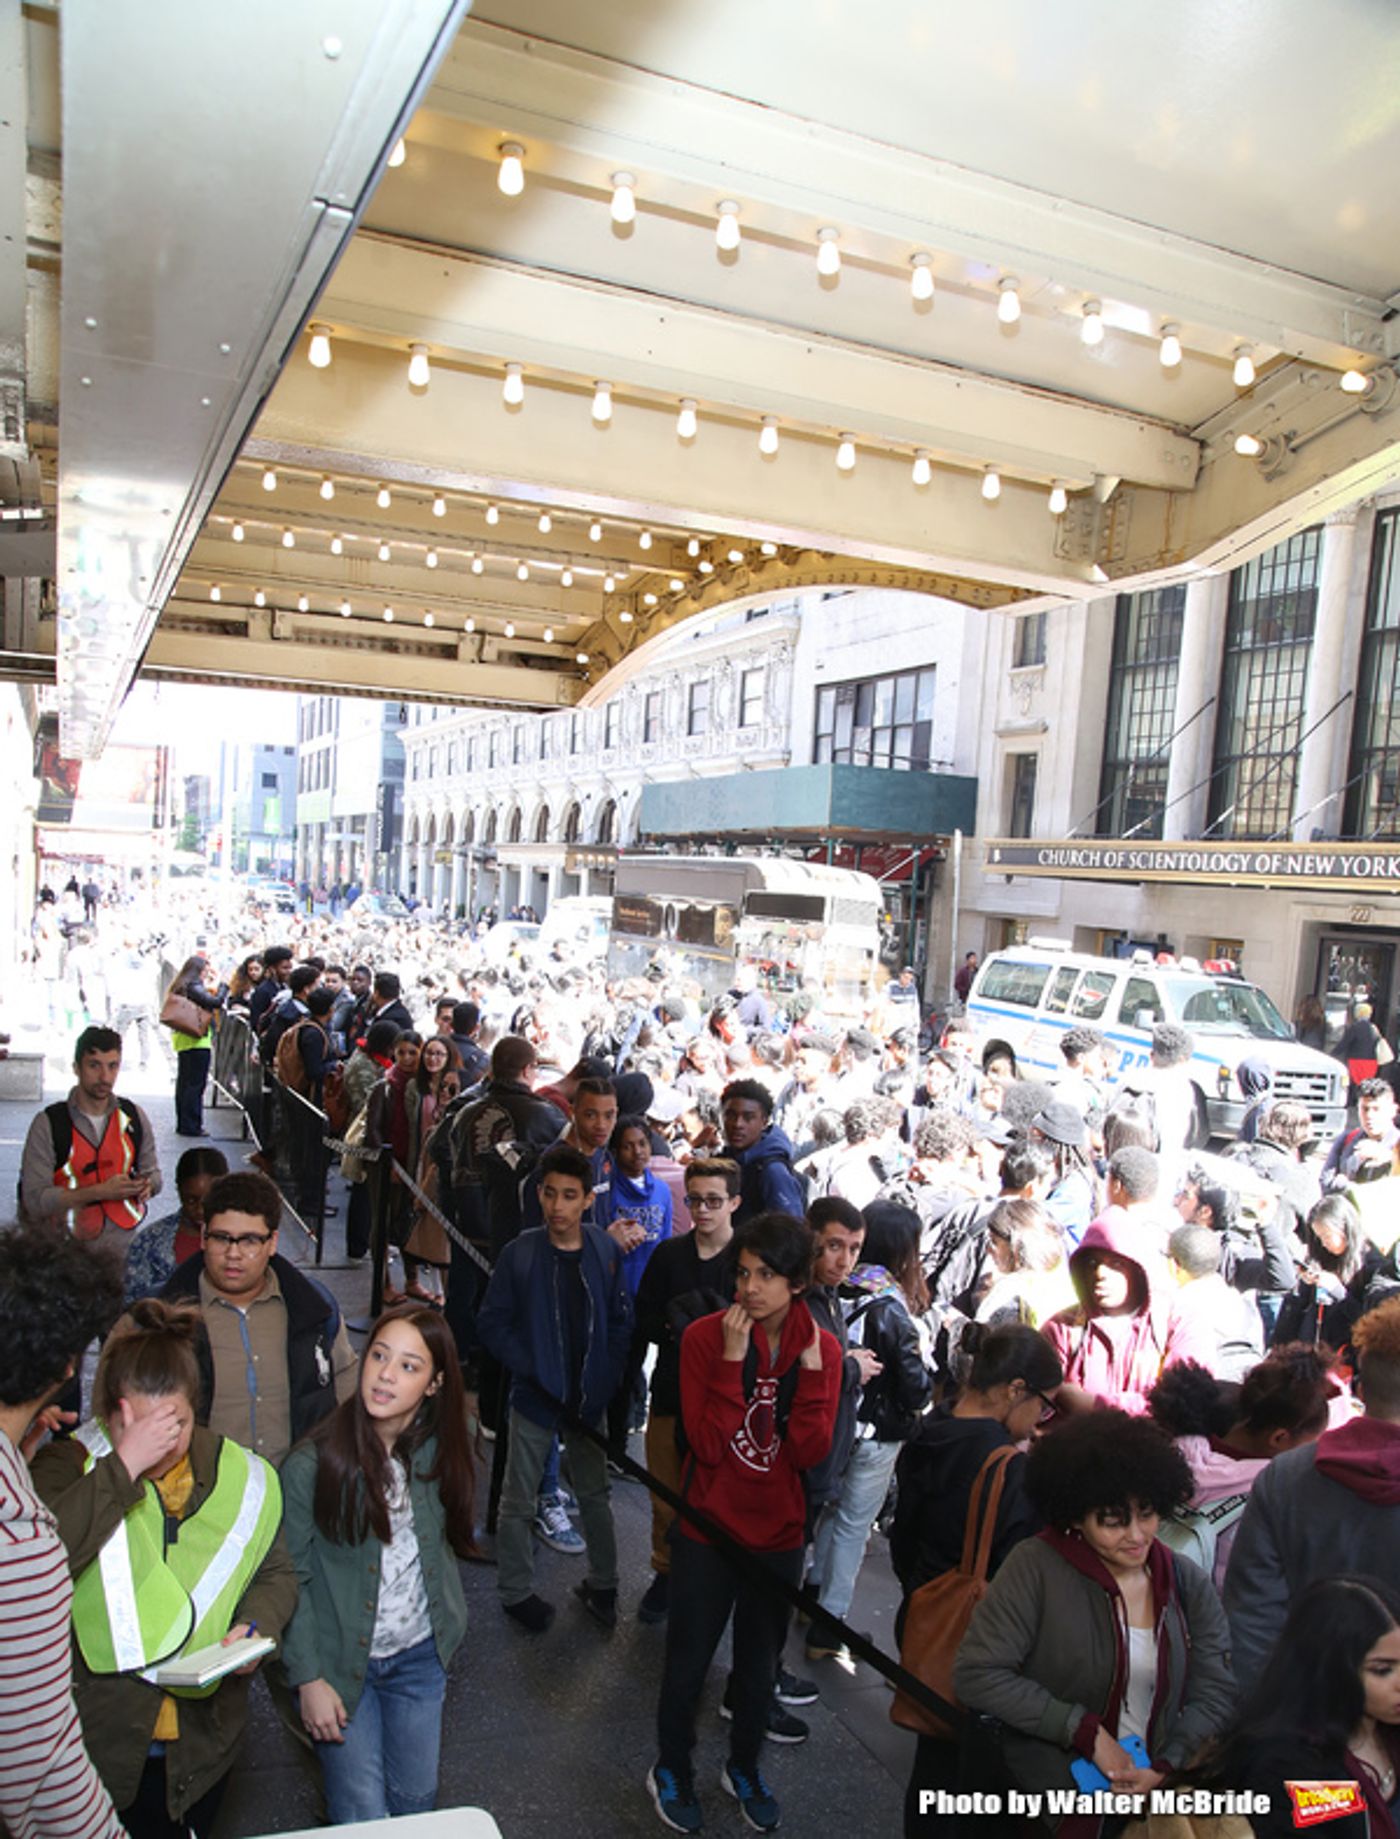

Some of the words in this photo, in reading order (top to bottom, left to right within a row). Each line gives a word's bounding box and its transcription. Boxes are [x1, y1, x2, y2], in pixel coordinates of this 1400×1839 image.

[1038, 849, 1100, 867] CHURCH
[1104, 851, 1127, 868] OF
[1128, 851, 1252, 872] SCIENTOLOGY
[1254, 853, 1282, 873] OF
[1286, 854, 1336, 875] NEW
[1340, 856, 1400, 877] YORK
